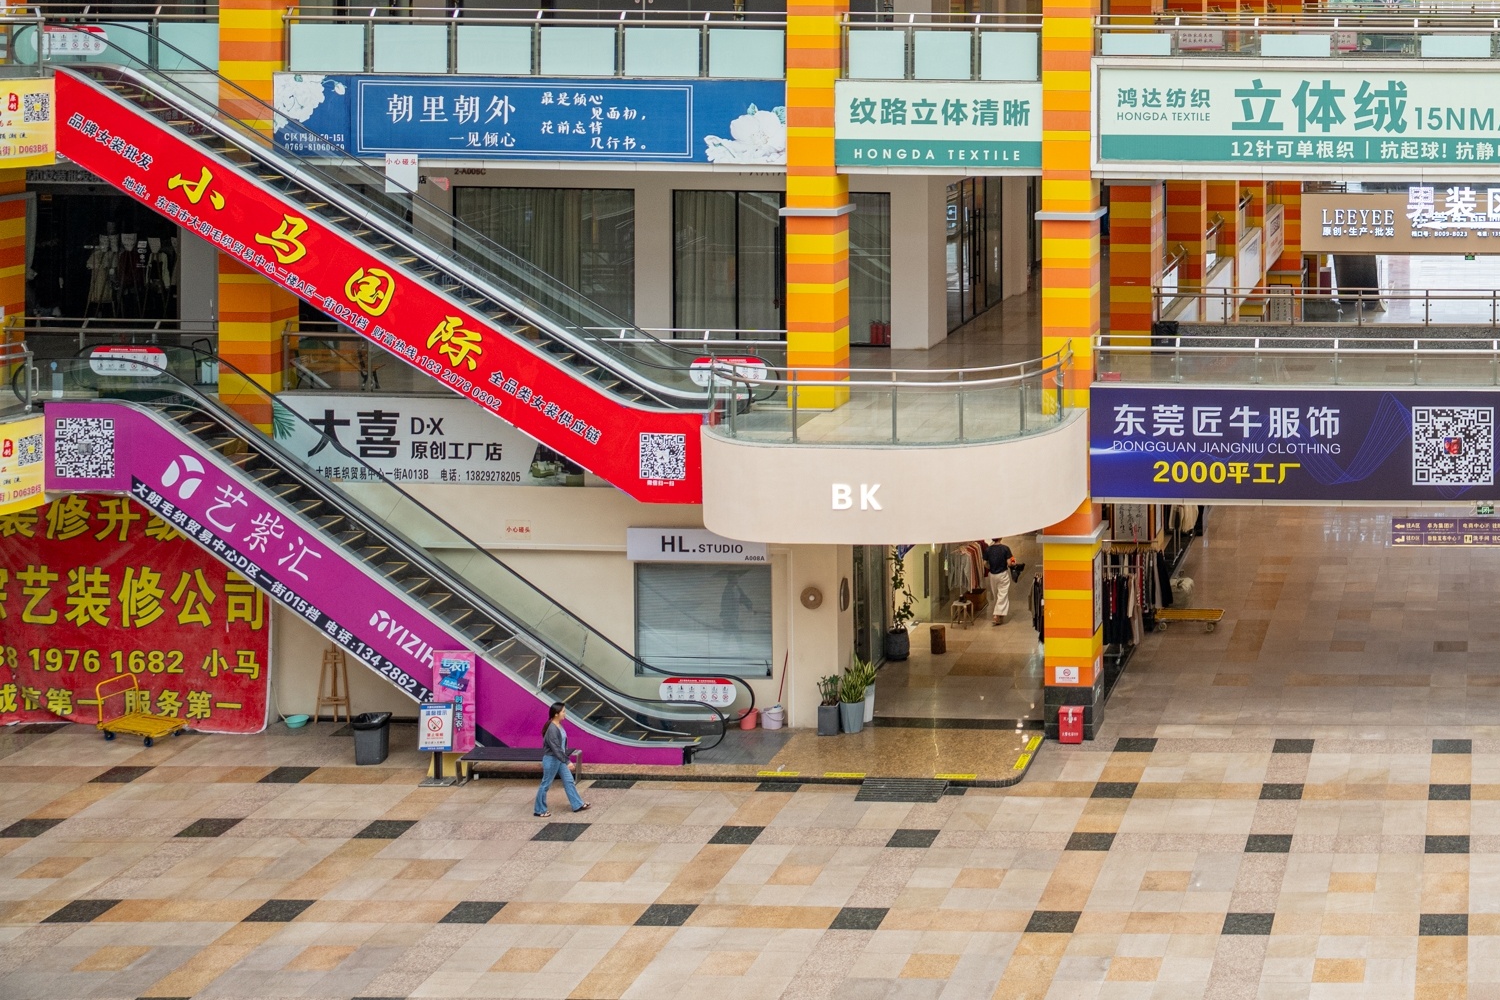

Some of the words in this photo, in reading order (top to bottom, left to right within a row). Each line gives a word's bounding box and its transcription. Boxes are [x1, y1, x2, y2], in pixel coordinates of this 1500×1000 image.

[386, 93, 517, 126] 朝里朝外
[540, 91, 603, 107] 最是倾心
[849, 97, 1030, 127] 纹路立体清晰
[1117, 87, 1211, 109] 鸿达纺织
[1231, 78, 1408, 134] 立体绒
[1117, 111, 1168, 121] HONGDA
[1172, 111, 1210, 122] TEXTILE
[67, 111, 153, 171] 品牌女装批发
[448, 130, 516, 148] 一见倾心
[1231, 140, 1355, 159] 12针可单根织
[386, 158, 417, 166] 小心碰头
[853, 148, 935, 160] HONGDA
[948, 149, 1021, 161] TEXTILE
[1321, 209, 1395, 226] LEEYEE
[168, 165, 483, 371] 小马国际
[442, 368, 472, 395] 2078
[471, 385, 502, 412] 0802
[489, 370, 602, 445] 全品类女装供应链
[1112, 403, 1341, 439] 东莞匠牛服饰
[308, 409, 400, 459] 大喜
[1113, 440, 1196, 453] DONGGUAN
[1199, 441, 1265, 454] JIANGNIU
[1267, 443, 1341, 455] CLOTHING
[410, 441, 503, 461] 原创工厂店
[1153, 460, 1301, 485] 2000平工厂
[832, 483, 882, 511] BK
[205, 484, 322, 582] 艺紫汇
[0, 564, 265, 630] 艺装修公司
[28, 648, 100, 673] 1976
[110, 649, 184, 674] 1682
[201, 649, 260, 680] 小马
[380, 661, 418, 691] 2862
[125, 689, 242, 720] 服务第一
